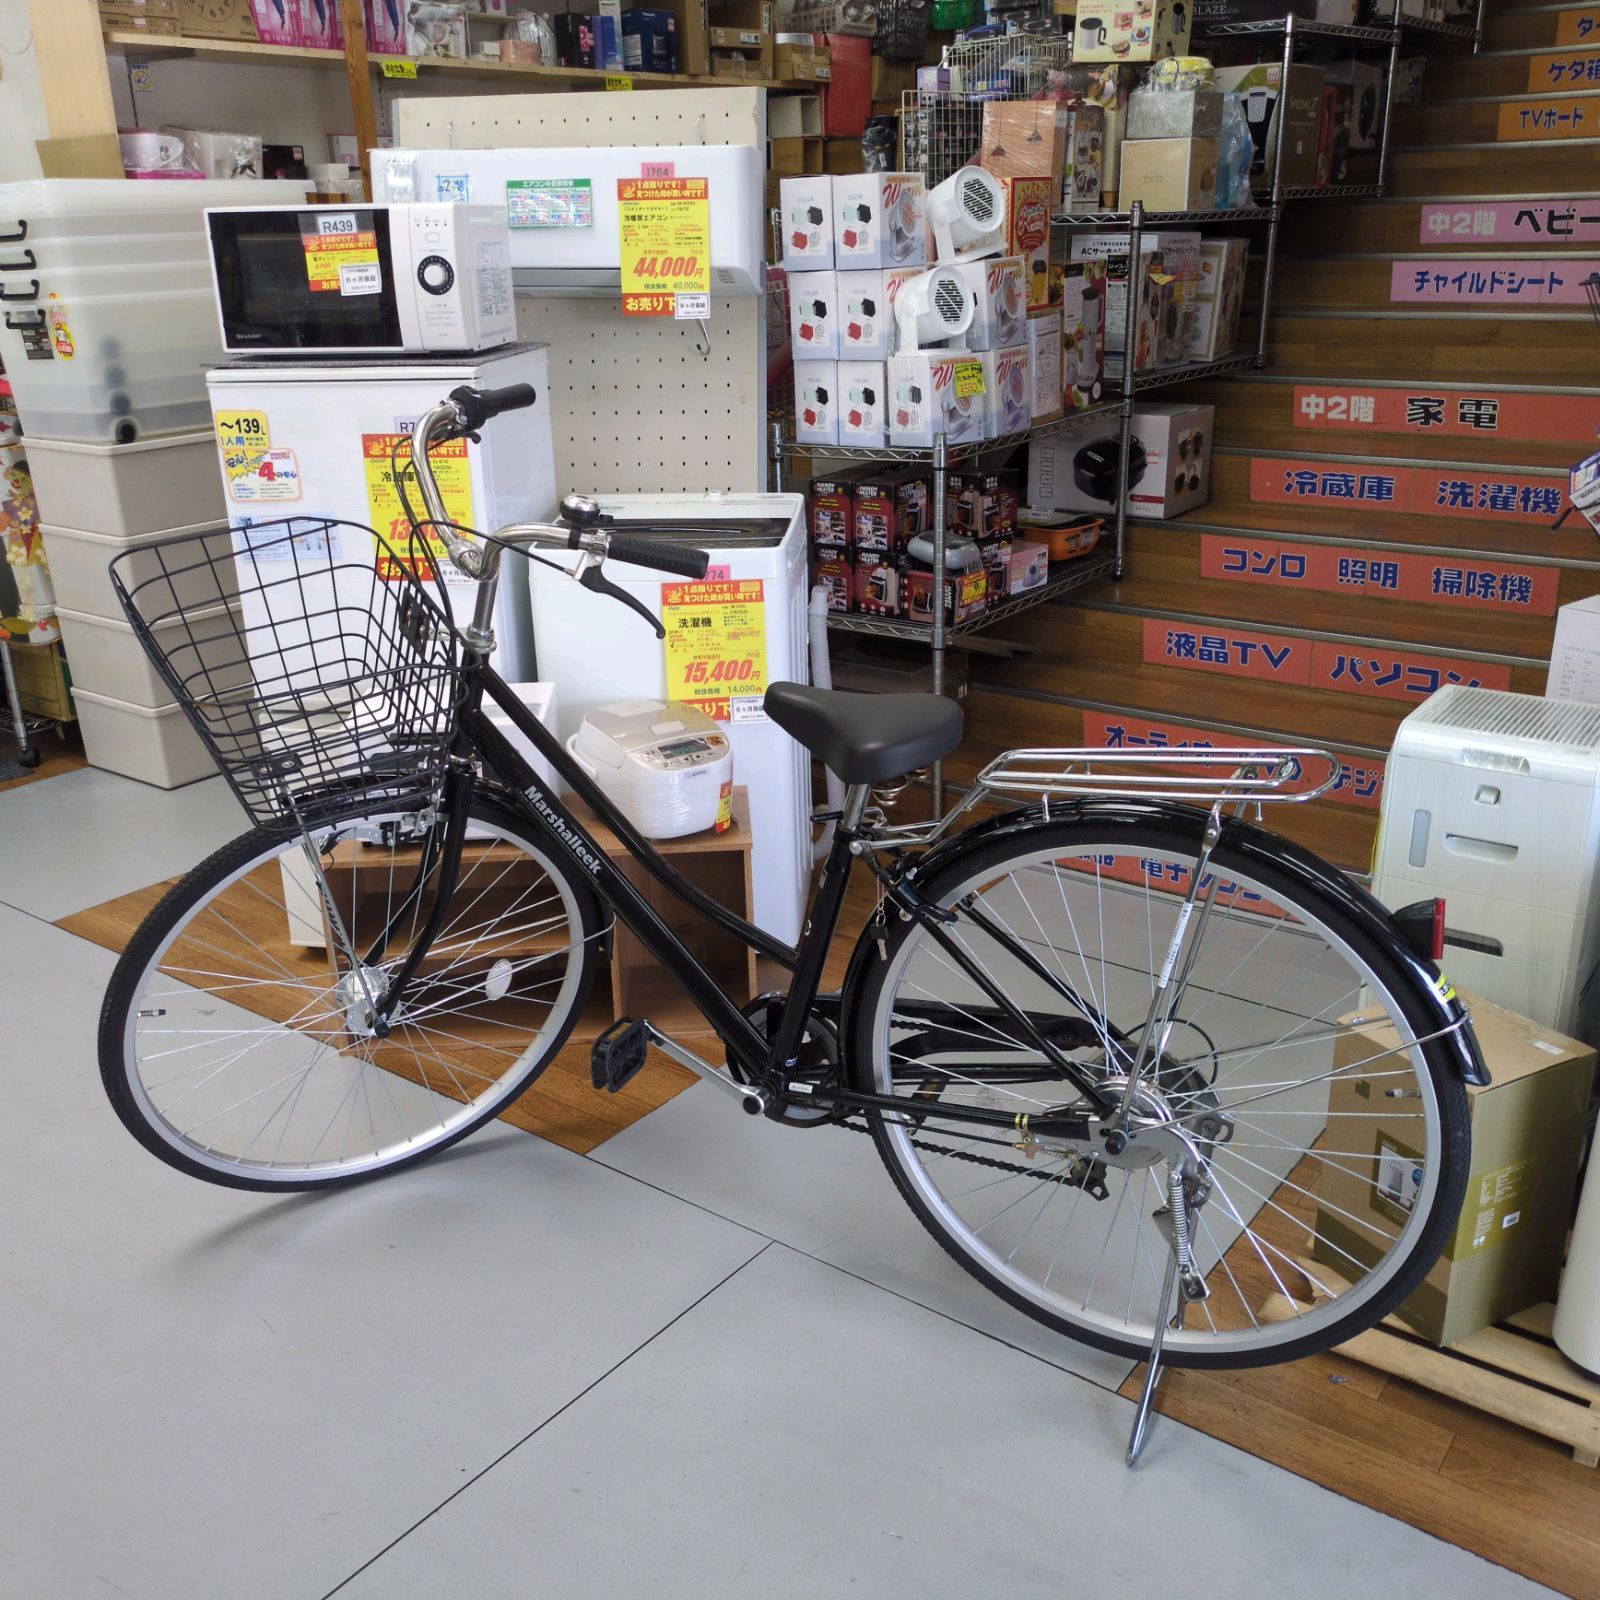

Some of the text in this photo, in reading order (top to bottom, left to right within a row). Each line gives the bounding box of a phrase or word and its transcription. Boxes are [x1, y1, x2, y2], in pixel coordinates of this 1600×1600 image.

[1576, 15, 1600, 38] ダ
[1519, 107, 1585, 131] TVボード
[646, 167, 670, 178] 1764
[322, 220, 353, 233] R439
[1428, 211, 1497, 236] 中2階
[1414, 270, 1565, 295] チャイルドシート
[1300, 395, 1376, 422] 中2階
[221, 436, 245, 446] 1人用
[1283, 470, 1562, 516] 冷蔵庫 洗濯機
[1222, 549, 1534, 604] コンロ 照明 掃除機
[678, 617, 713, 629] 洗濯機
[683, 659, 762, 685] 15,400円
[1164, 630, 1482, 696] 液晶TV パソコン
[524, 785, 602, 875] Marshalleek
